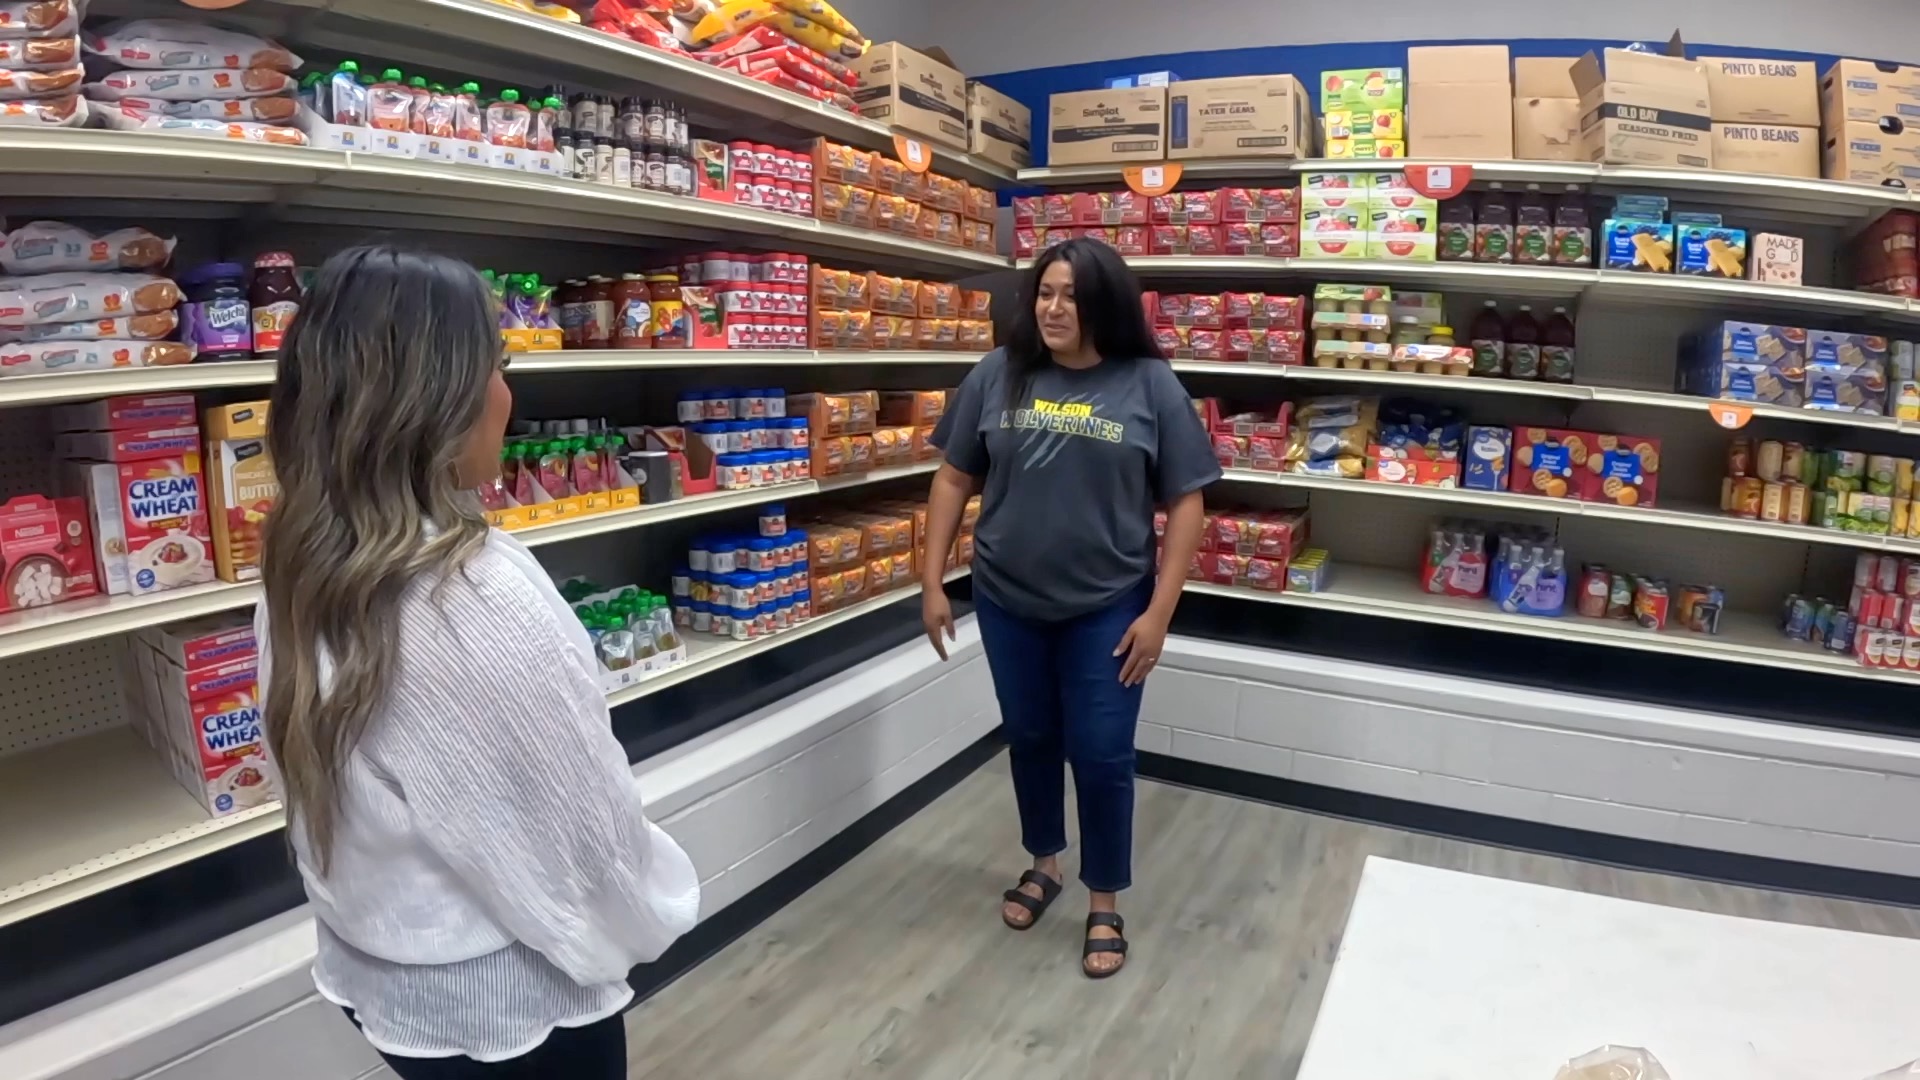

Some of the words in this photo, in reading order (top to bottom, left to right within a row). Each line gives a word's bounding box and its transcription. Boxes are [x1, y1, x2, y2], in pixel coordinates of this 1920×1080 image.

[1721, 62, 1756, 75] PINTO
[1759, 64, 1797, 77] BEANS
[1082, 107, 1119, 118] Simplot
[1199, 106, 1226, 117] TATER
[1229, 106, 1256, 115] GEMS
[1618, 123, 1669, 137] SEASONED
[1723, 126, 1758, 141] PINTO
[1761, 128, 1799, 143] BEANS
[1767, 238, 1799, 250] MADE
[212, 306, 245, 325] Welch's
[1034, 399, 1093, 417] WILSON
[1000, 408, 1125, 443] WOLVERINES
[129, 477, 197, 499] CREAM
[131, 496, 198, 518] WHEAT
[206, 725, 263, 750] WHEA
